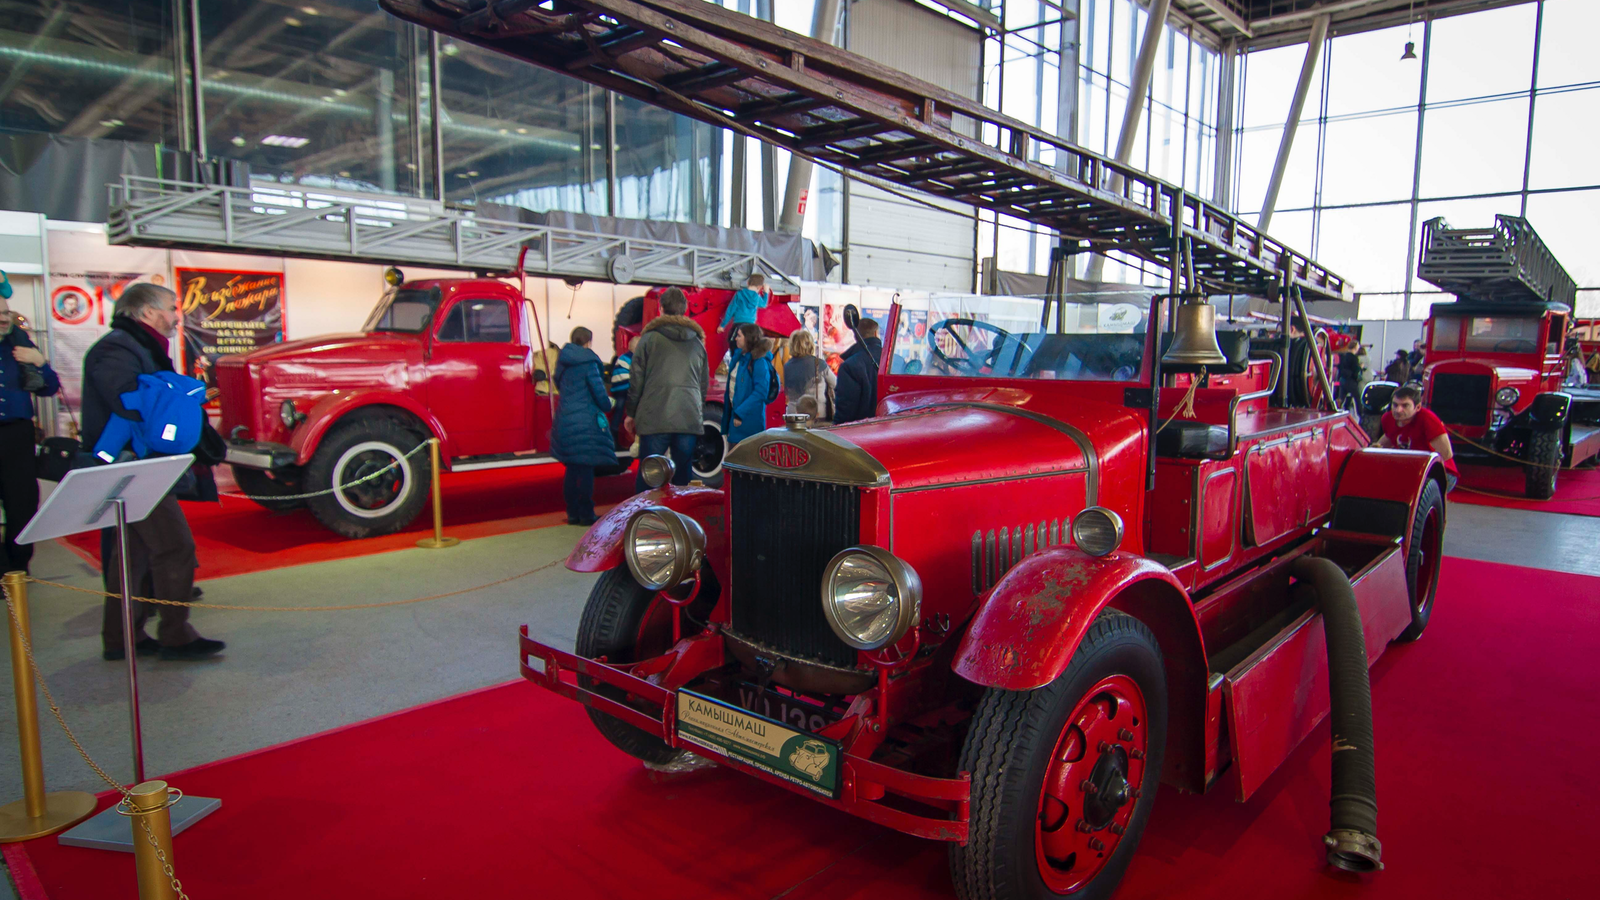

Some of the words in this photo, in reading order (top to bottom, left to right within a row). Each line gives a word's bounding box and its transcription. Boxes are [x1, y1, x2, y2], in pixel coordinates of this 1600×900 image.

[182, 276, 209, 316] Во
[225, 287, 278, 314] пожара
[202, 345, 217, 354] СО
[761, 443, 807, 467] DENNIS
[688, 698, 766, 737] КАМЫШМАШ
